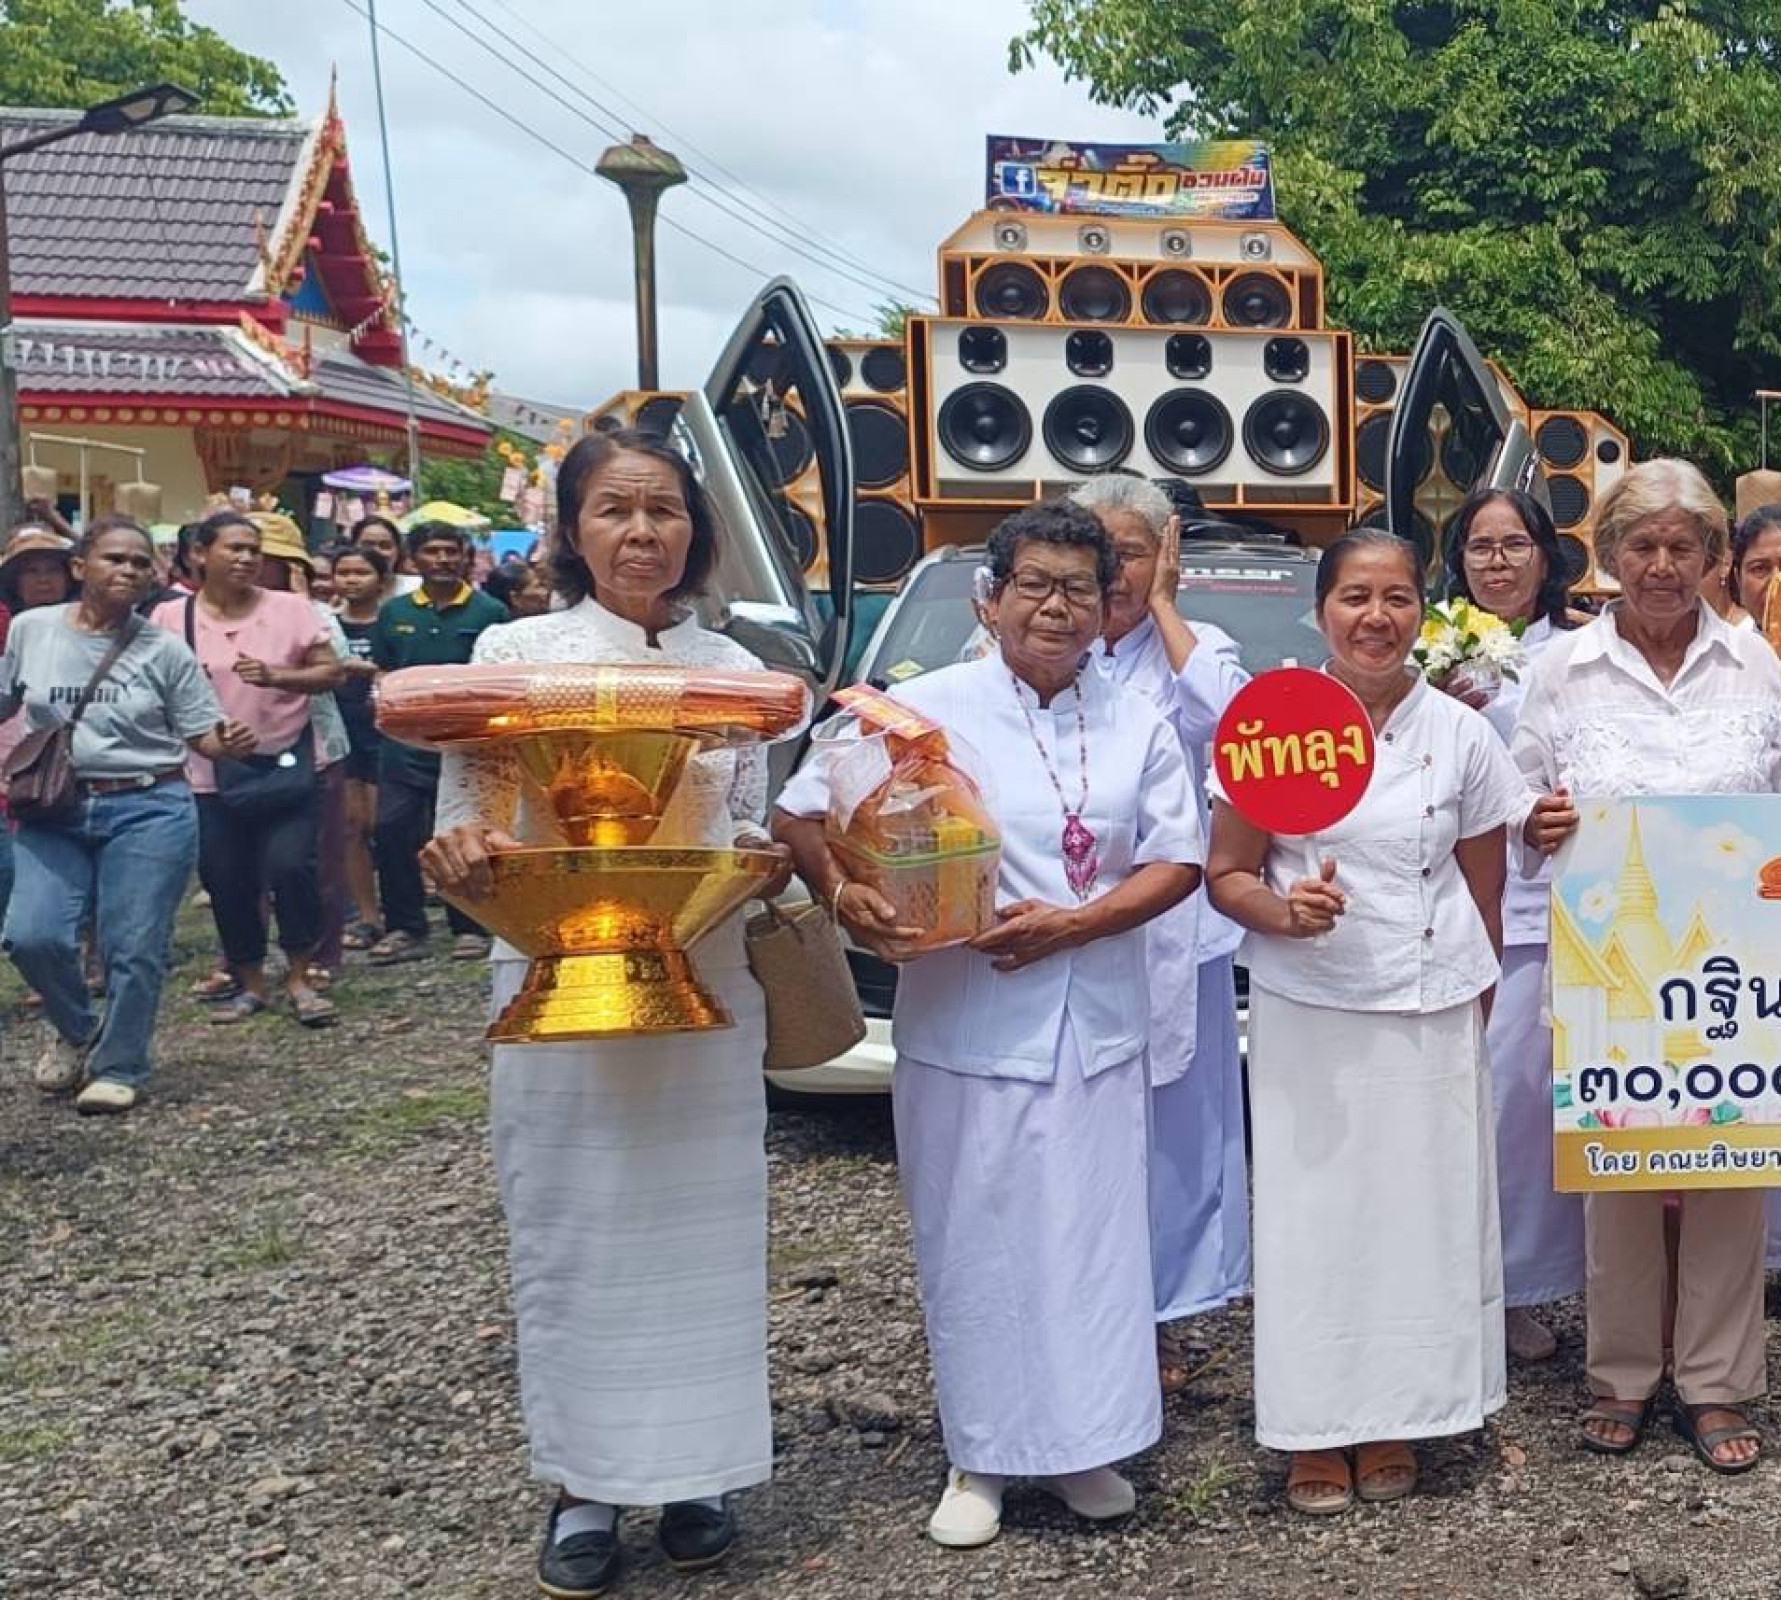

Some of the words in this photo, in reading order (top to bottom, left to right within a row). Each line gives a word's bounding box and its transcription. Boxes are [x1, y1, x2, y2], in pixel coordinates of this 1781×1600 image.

[1220, 719, 1367, 789] พัทลุง
[1585, 1145, 1638, 1173] โดย
